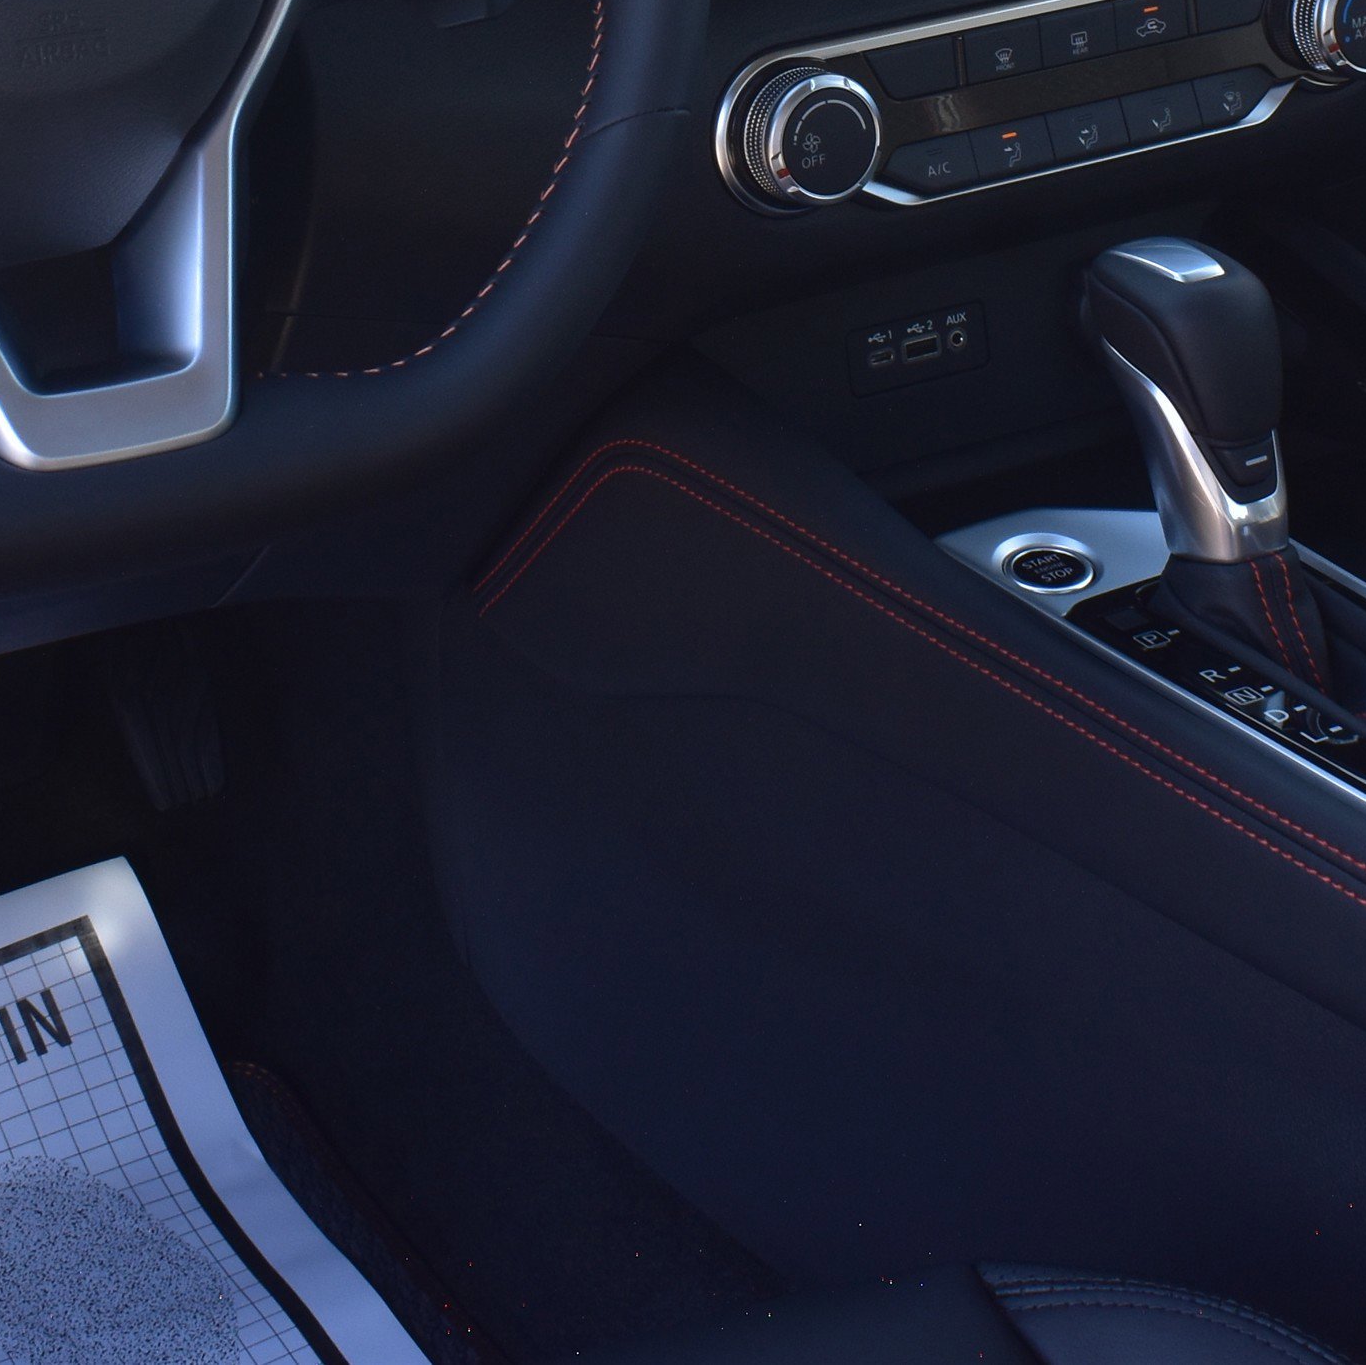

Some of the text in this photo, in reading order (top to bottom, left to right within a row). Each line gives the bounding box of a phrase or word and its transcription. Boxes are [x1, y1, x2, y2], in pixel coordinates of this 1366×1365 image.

[801, 153, 827, 170] OFF
[928, 161, 952, 178] A/C
[926, 319, 934, 330] 2
[945, 312, 967, 326] AUX
[1021, 554, 1061, 570] START
[1040, 566, 1073, 582] STOP
[1199, 669, 1227, 683] R
[1264, 708, 1290, 724] D
